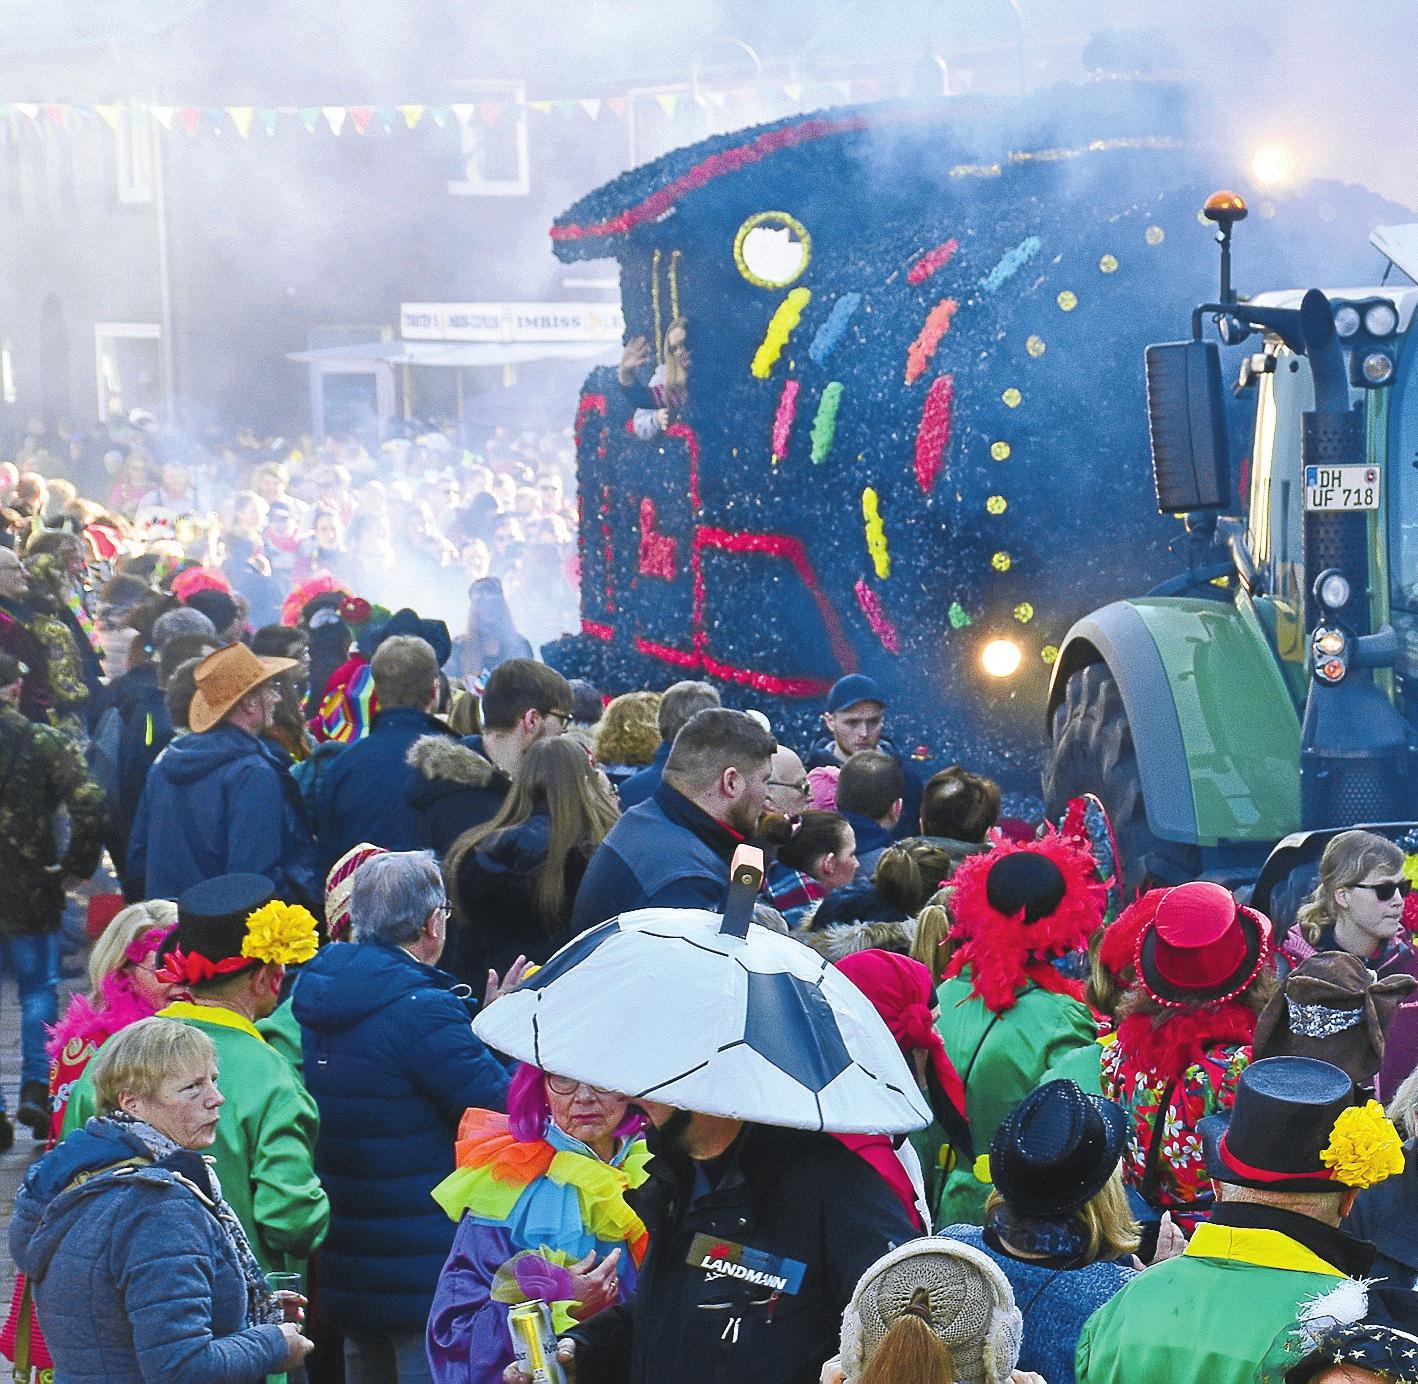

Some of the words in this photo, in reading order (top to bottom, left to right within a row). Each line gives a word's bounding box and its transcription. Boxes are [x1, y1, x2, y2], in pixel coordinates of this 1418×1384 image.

[517, 315, 581, 329] IMBISS
[1320, 470, 1342, 488] DH
[1312, 489, 1334, 507] UF
[1342, 488, 1374, 507] 718
